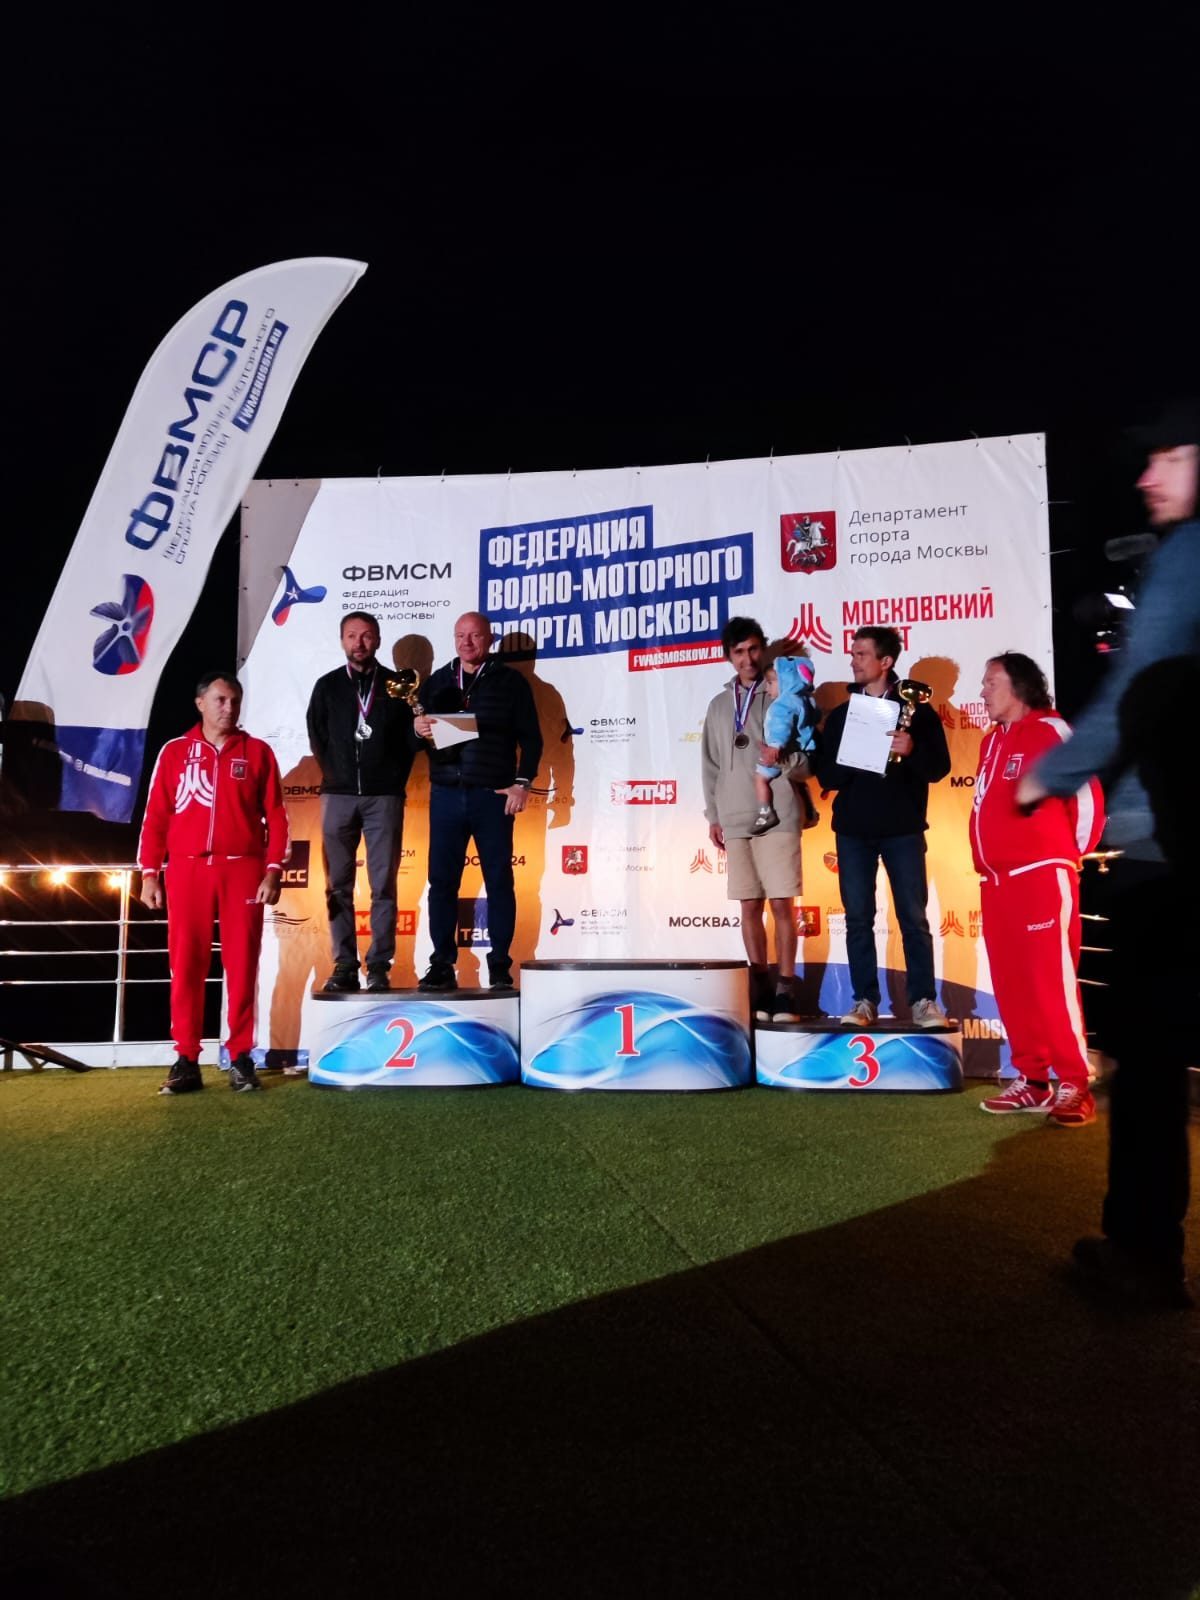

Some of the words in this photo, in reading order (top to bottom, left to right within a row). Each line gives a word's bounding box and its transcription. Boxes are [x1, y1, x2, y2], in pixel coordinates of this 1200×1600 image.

[125, 299, 249, 551] ФВМСР
[849, 504, 968, 527] Департамент
[488, 515, 646, 570] ФЕДЕРАЦИЯ
[850, 528, 910, 546] спорта
[850, 550, 911, 566] города
[917, 544, 988, 560] Москвы
[342, 562, 452, 581] ФВМСМ
[487, 545, 743, 614] ВОДНО-МОТОРНОГО
[342, 589, 409, 598] ФЕДЕРАЦИЯ
[342, 600, 451, 610] ВОДНО-МОТОРНОГО
[387, 612, 435, 620] МОСКВЫ
[842, 586, 994, 626] МОСКОВСКИЙ
[489, 613, 584, 654] СПОРТА
[595, 596, 718, 645] МОСКВЫ
[633, 645, 724, 667] FWMSMOSKOW.RU
[590, 717, 636, 727] ФВМСМ
[669, 917, 741, 927] МОСКВА2
[614, 1003, 641, 1057] 1
[385, 1018, 417, 1069] 2
[847, 1034, 880, 1088] 3
